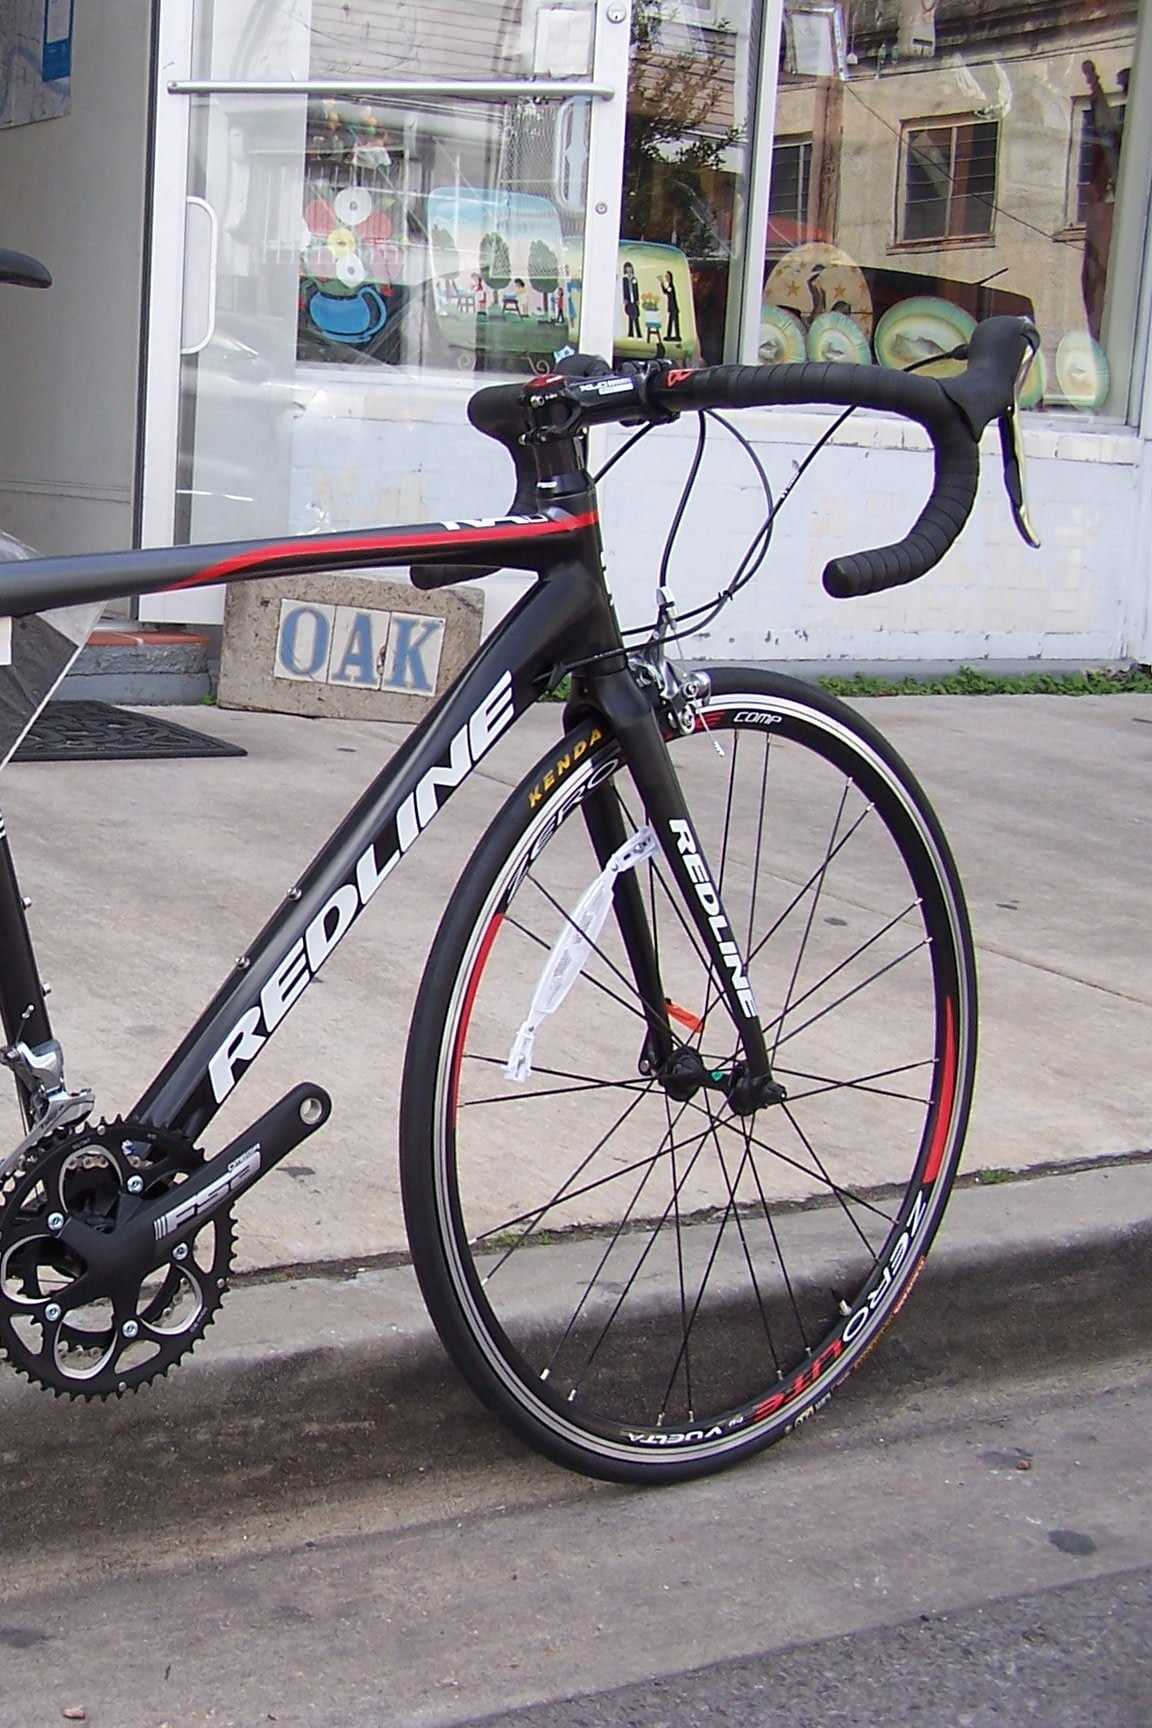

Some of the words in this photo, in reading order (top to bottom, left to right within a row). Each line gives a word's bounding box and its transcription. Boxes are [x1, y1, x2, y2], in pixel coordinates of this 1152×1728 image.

[279, 605, 442, 692] OAK
[733, 711, 783, 726] COMP
[528, 728, 603, 809] KENDA
[207, 670, 516, 1104] REDLINE
[668, 817, 759, 1019] REDLINE
[628, 1426, 723, 1445] VUELTA
